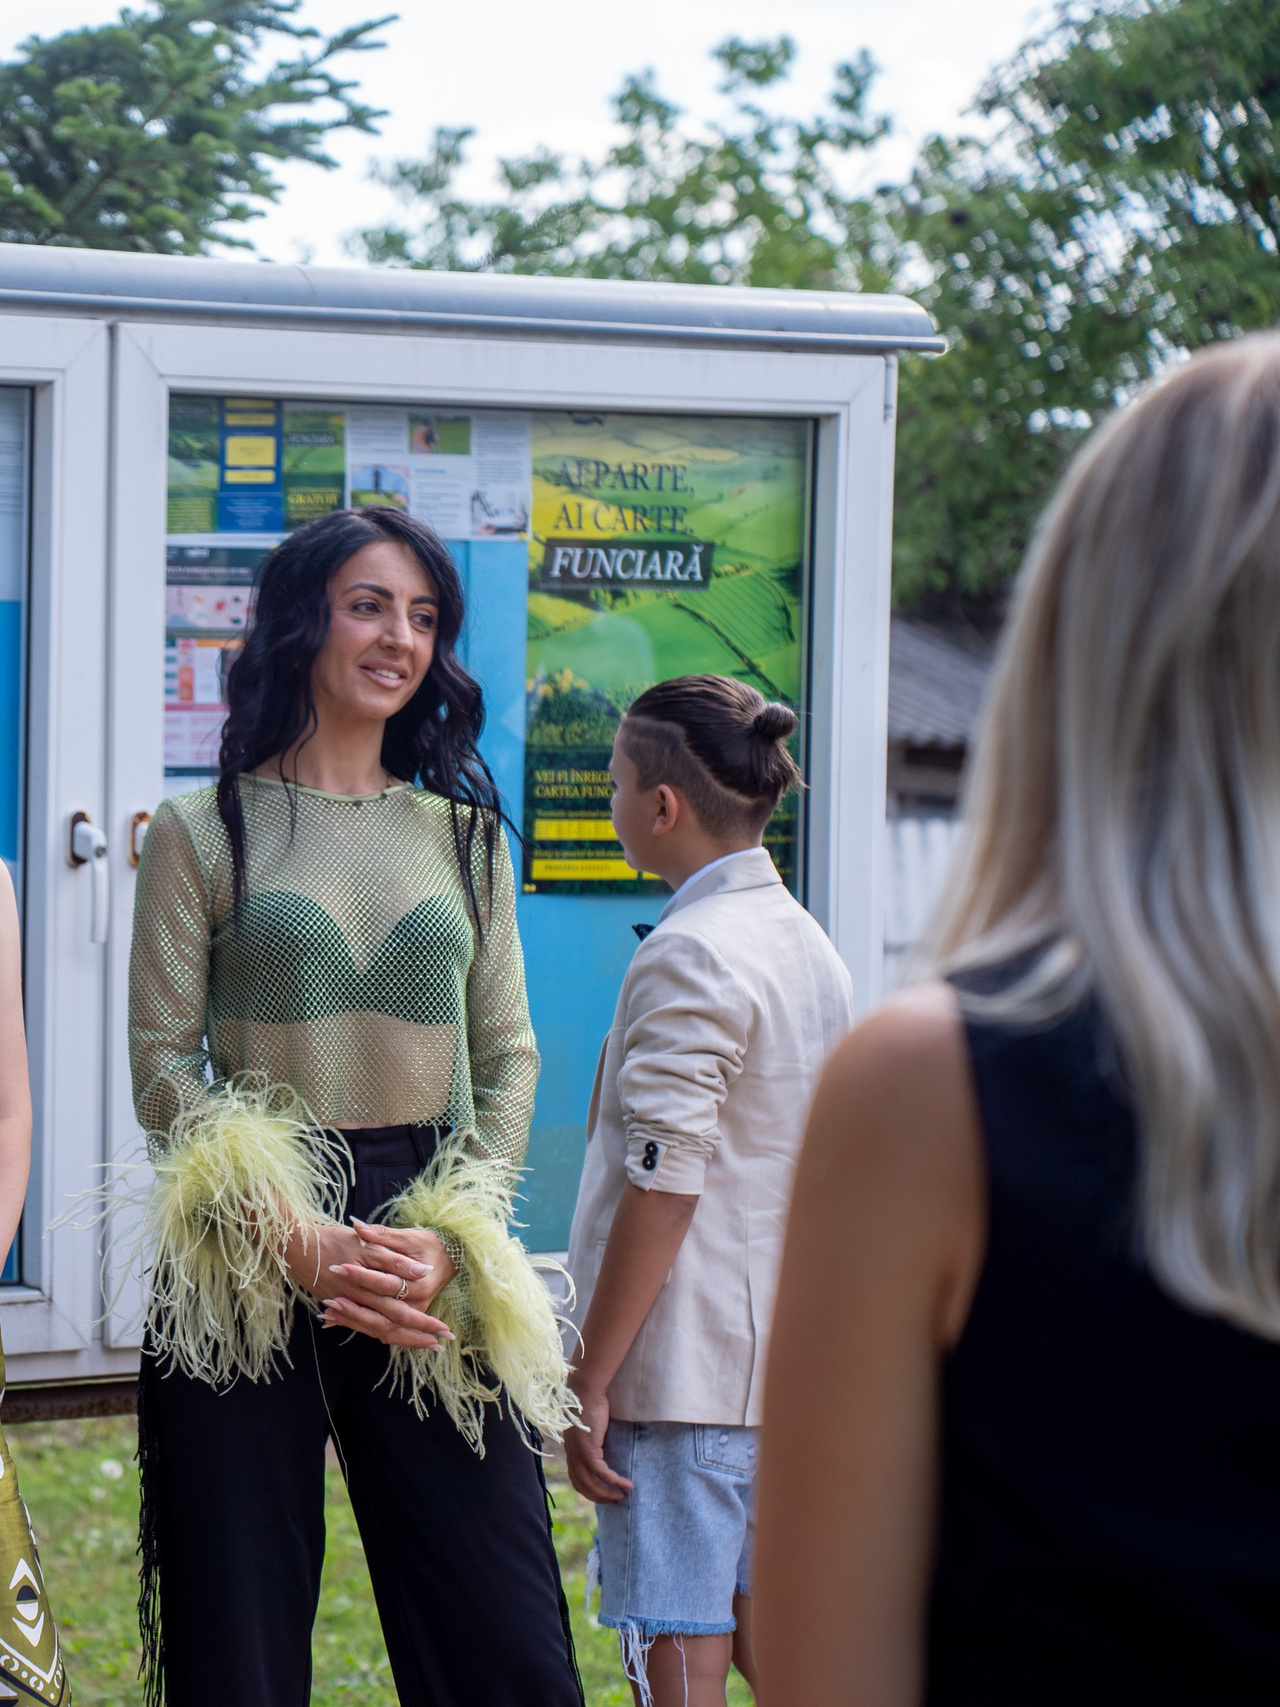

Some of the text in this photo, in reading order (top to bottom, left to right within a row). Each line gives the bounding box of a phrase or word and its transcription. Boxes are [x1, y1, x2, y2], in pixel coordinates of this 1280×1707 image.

[553, 459, 696, 499] AI PARTE,
[553, 502, 695, 535] AI CARTE.
[549, 542, 706, 582] FUNCIARĂ
[534, 783, 580, 798] CARTEA
